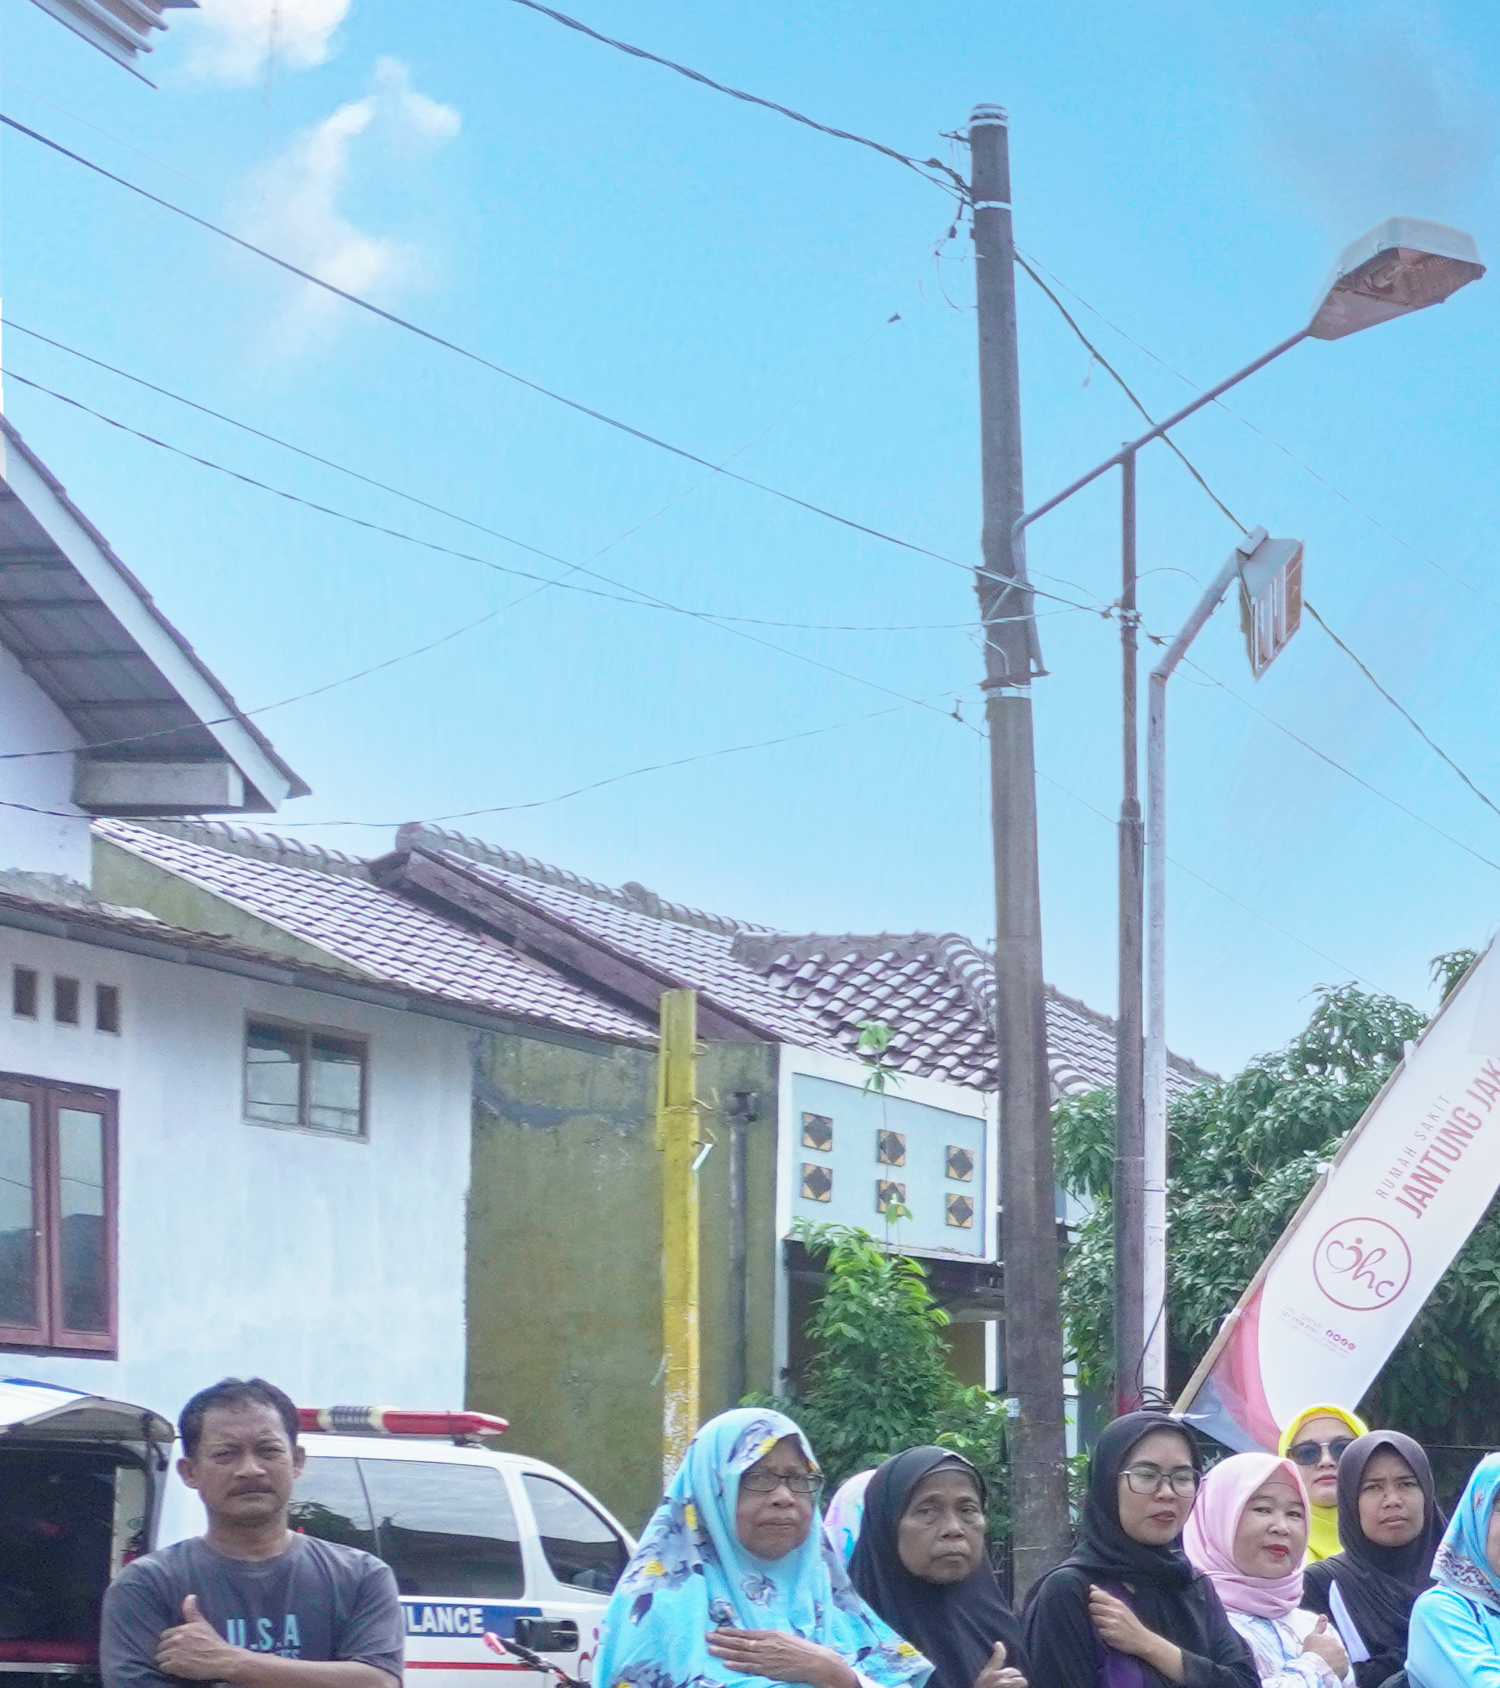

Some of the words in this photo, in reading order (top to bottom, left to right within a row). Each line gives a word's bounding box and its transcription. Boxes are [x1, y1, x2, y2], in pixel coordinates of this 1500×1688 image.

[1374, 1146, 1417, 1200] RUMAH
[1414, 1093, 1452, 1142] SAKIT
[1394, 1106, 1482, 1219] JANTUNG
